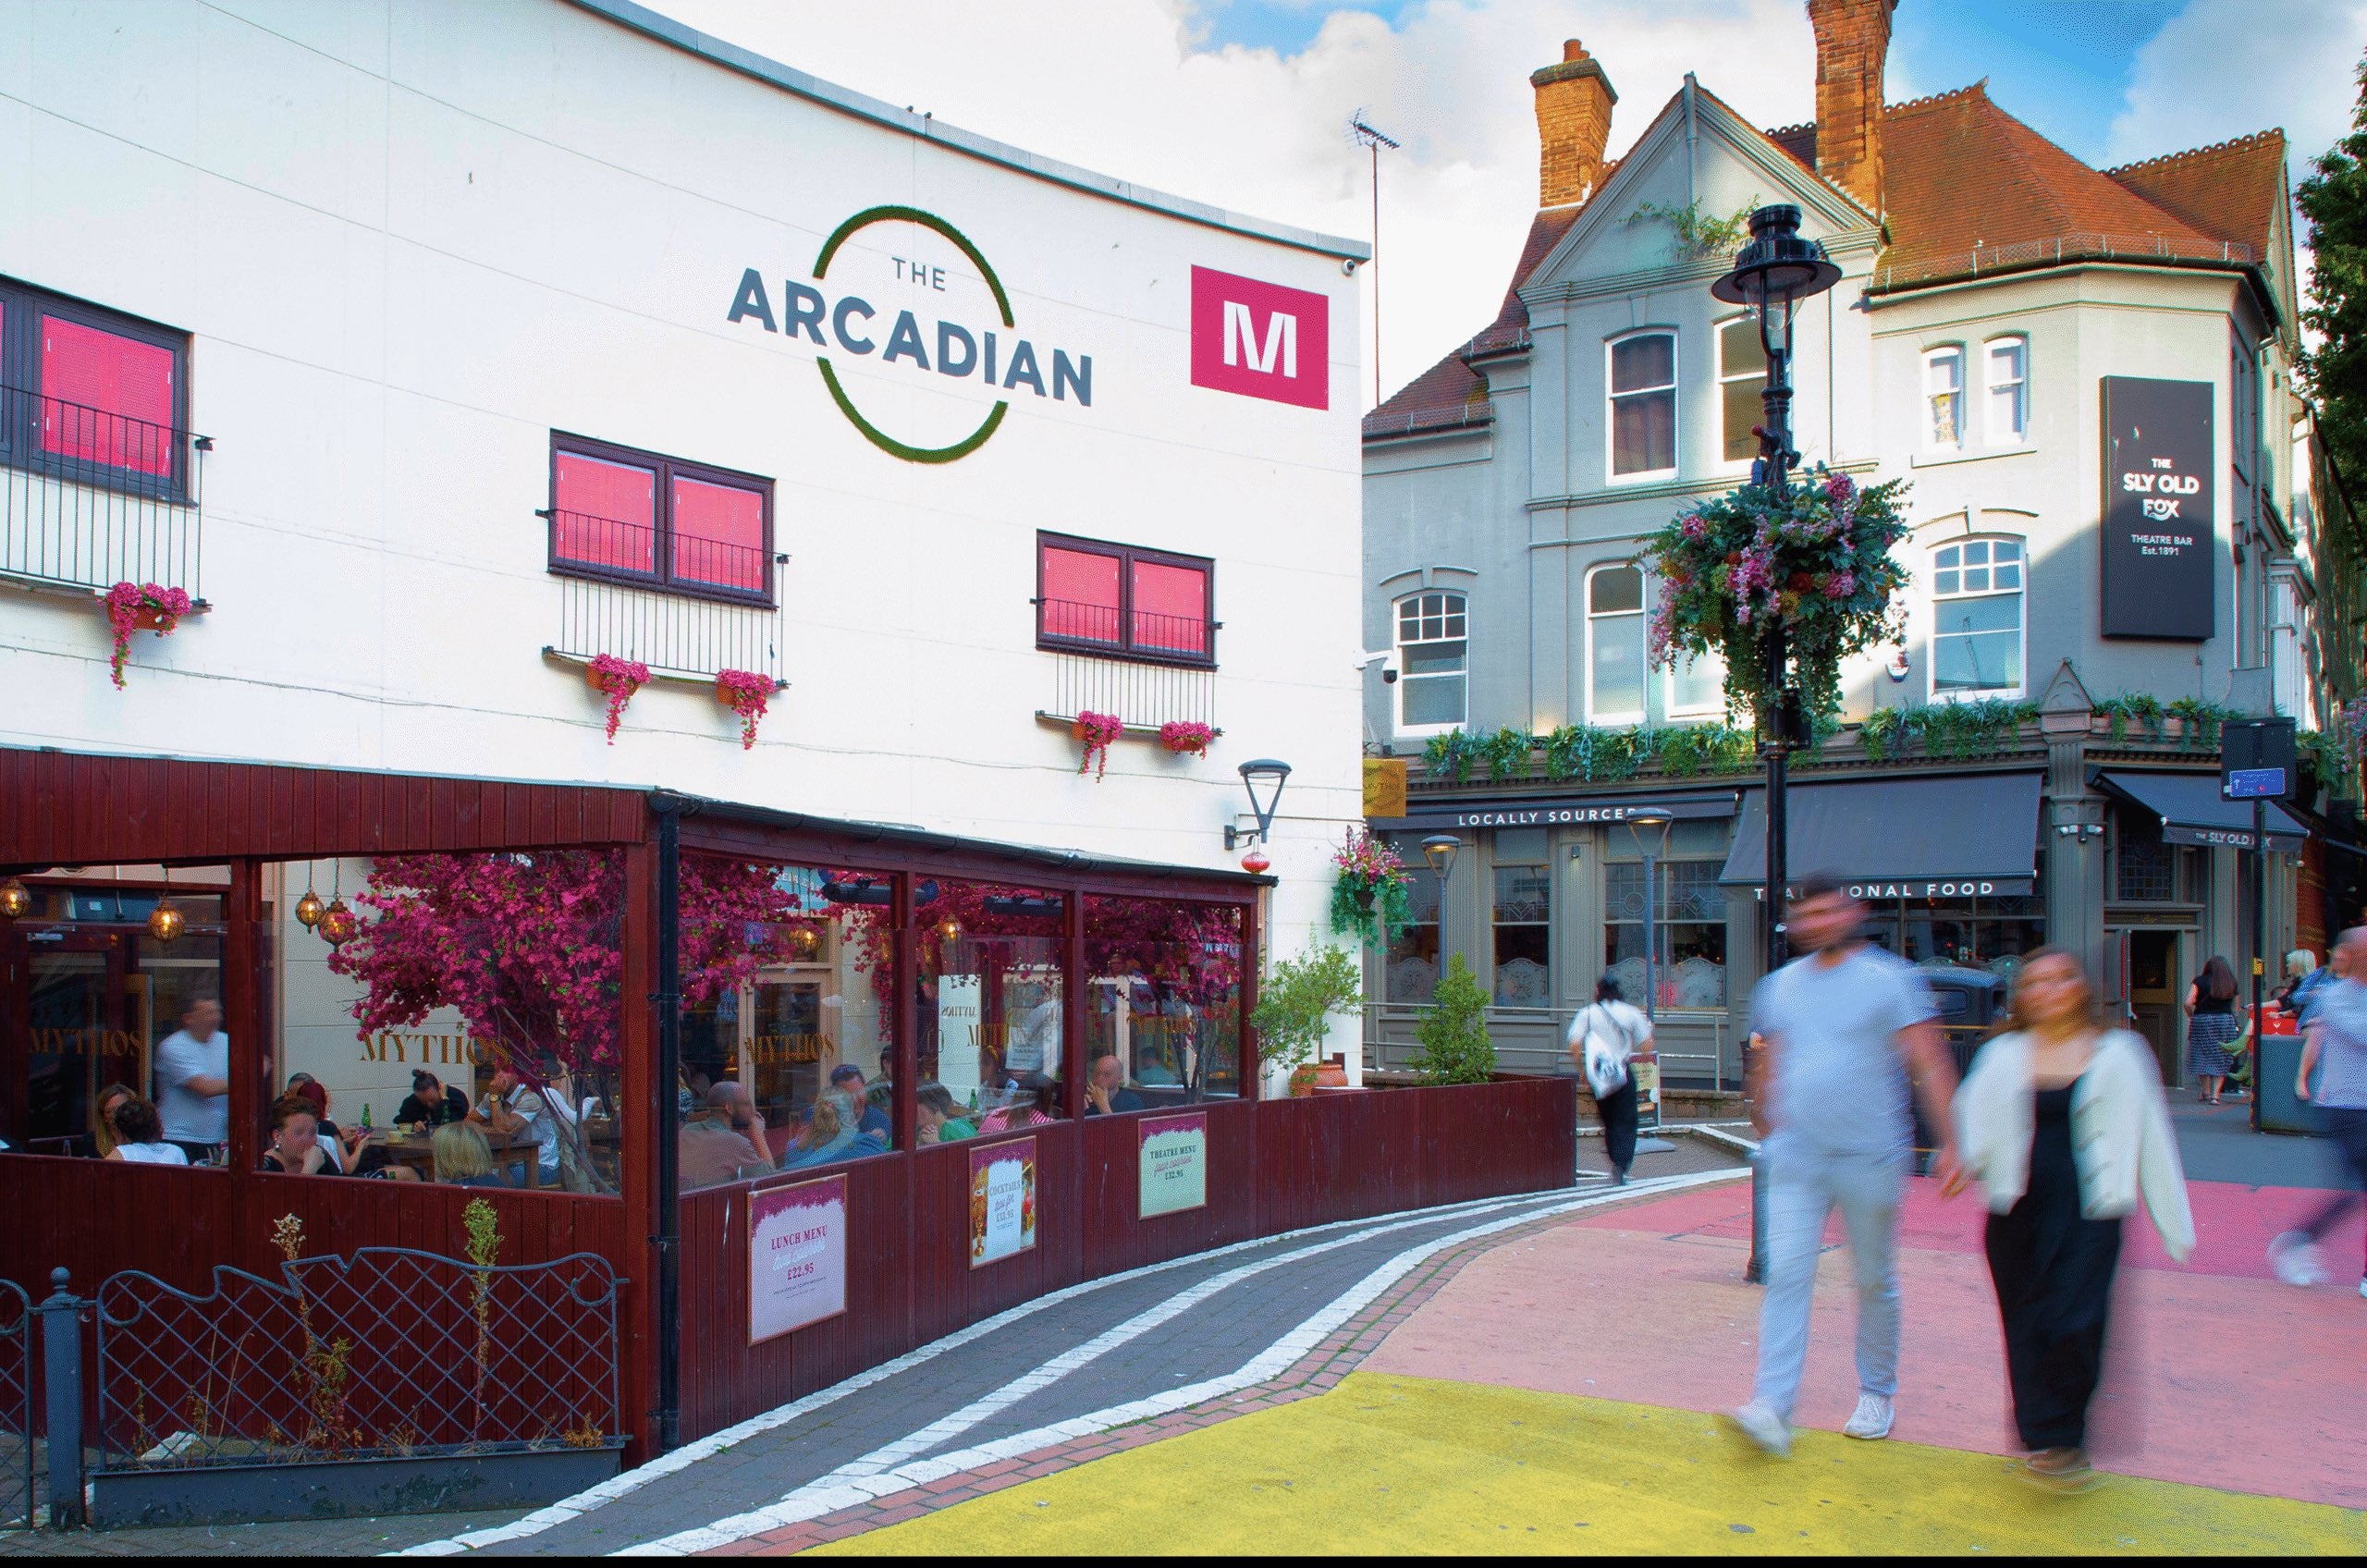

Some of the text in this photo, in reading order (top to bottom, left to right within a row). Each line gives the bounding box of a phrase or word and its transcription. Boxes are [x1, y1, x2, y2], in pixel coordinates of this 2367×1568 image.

[891, 257, 947, 292] THE
[726, 267, 1093, 408] ARCADIAN
[1222, 300, 1298, 379] M
[2152, 458, 2172, 469] THE
[2123, 472, 2200, 495] SLY OLD
[2142, 498, 2180, 521] FOX
[2131, 533, 2193, 546] THEATRE BAR
[1458, 807, 1636, 827] LOCALLY SOURCE
[2208, 831, 2226, 844] SLY
[2226, 833, 2250, 846] OLD
[1754, 881, 1993, 900] TAIONAL FOOD
[29, 1027, 140, 1057] MYTHOS
[1150, 1145, 1197, 1159] THEATRE MENU
[771, 1224, 828, 1251] LUNCH MENU
[787, 1262, 815, 1281] £22.95
